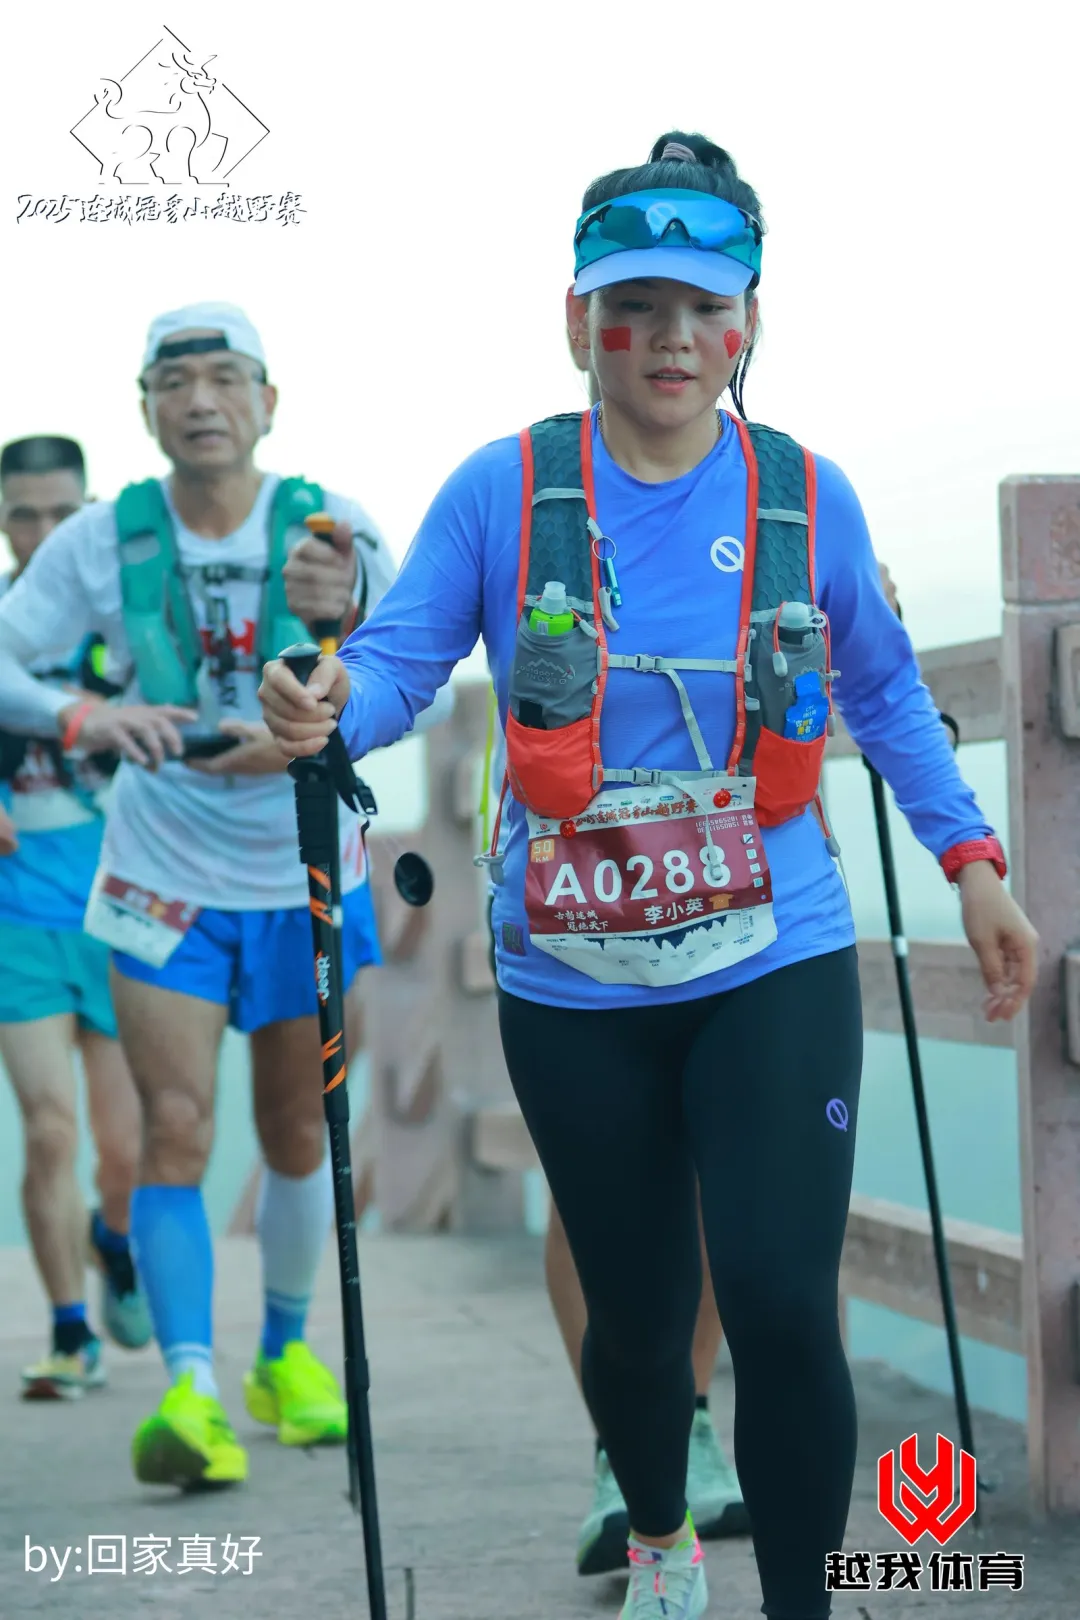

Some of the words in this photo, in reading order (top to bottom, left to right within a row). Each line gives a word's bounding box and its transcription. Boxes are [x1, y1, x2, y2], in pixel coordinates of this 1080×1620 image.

[533, 840, 552, 854] 50
[544, 845, 732, 906] A0288
[643, 897, 704, 925] 李小英
[316, 955, 330, 1000] Jeep
